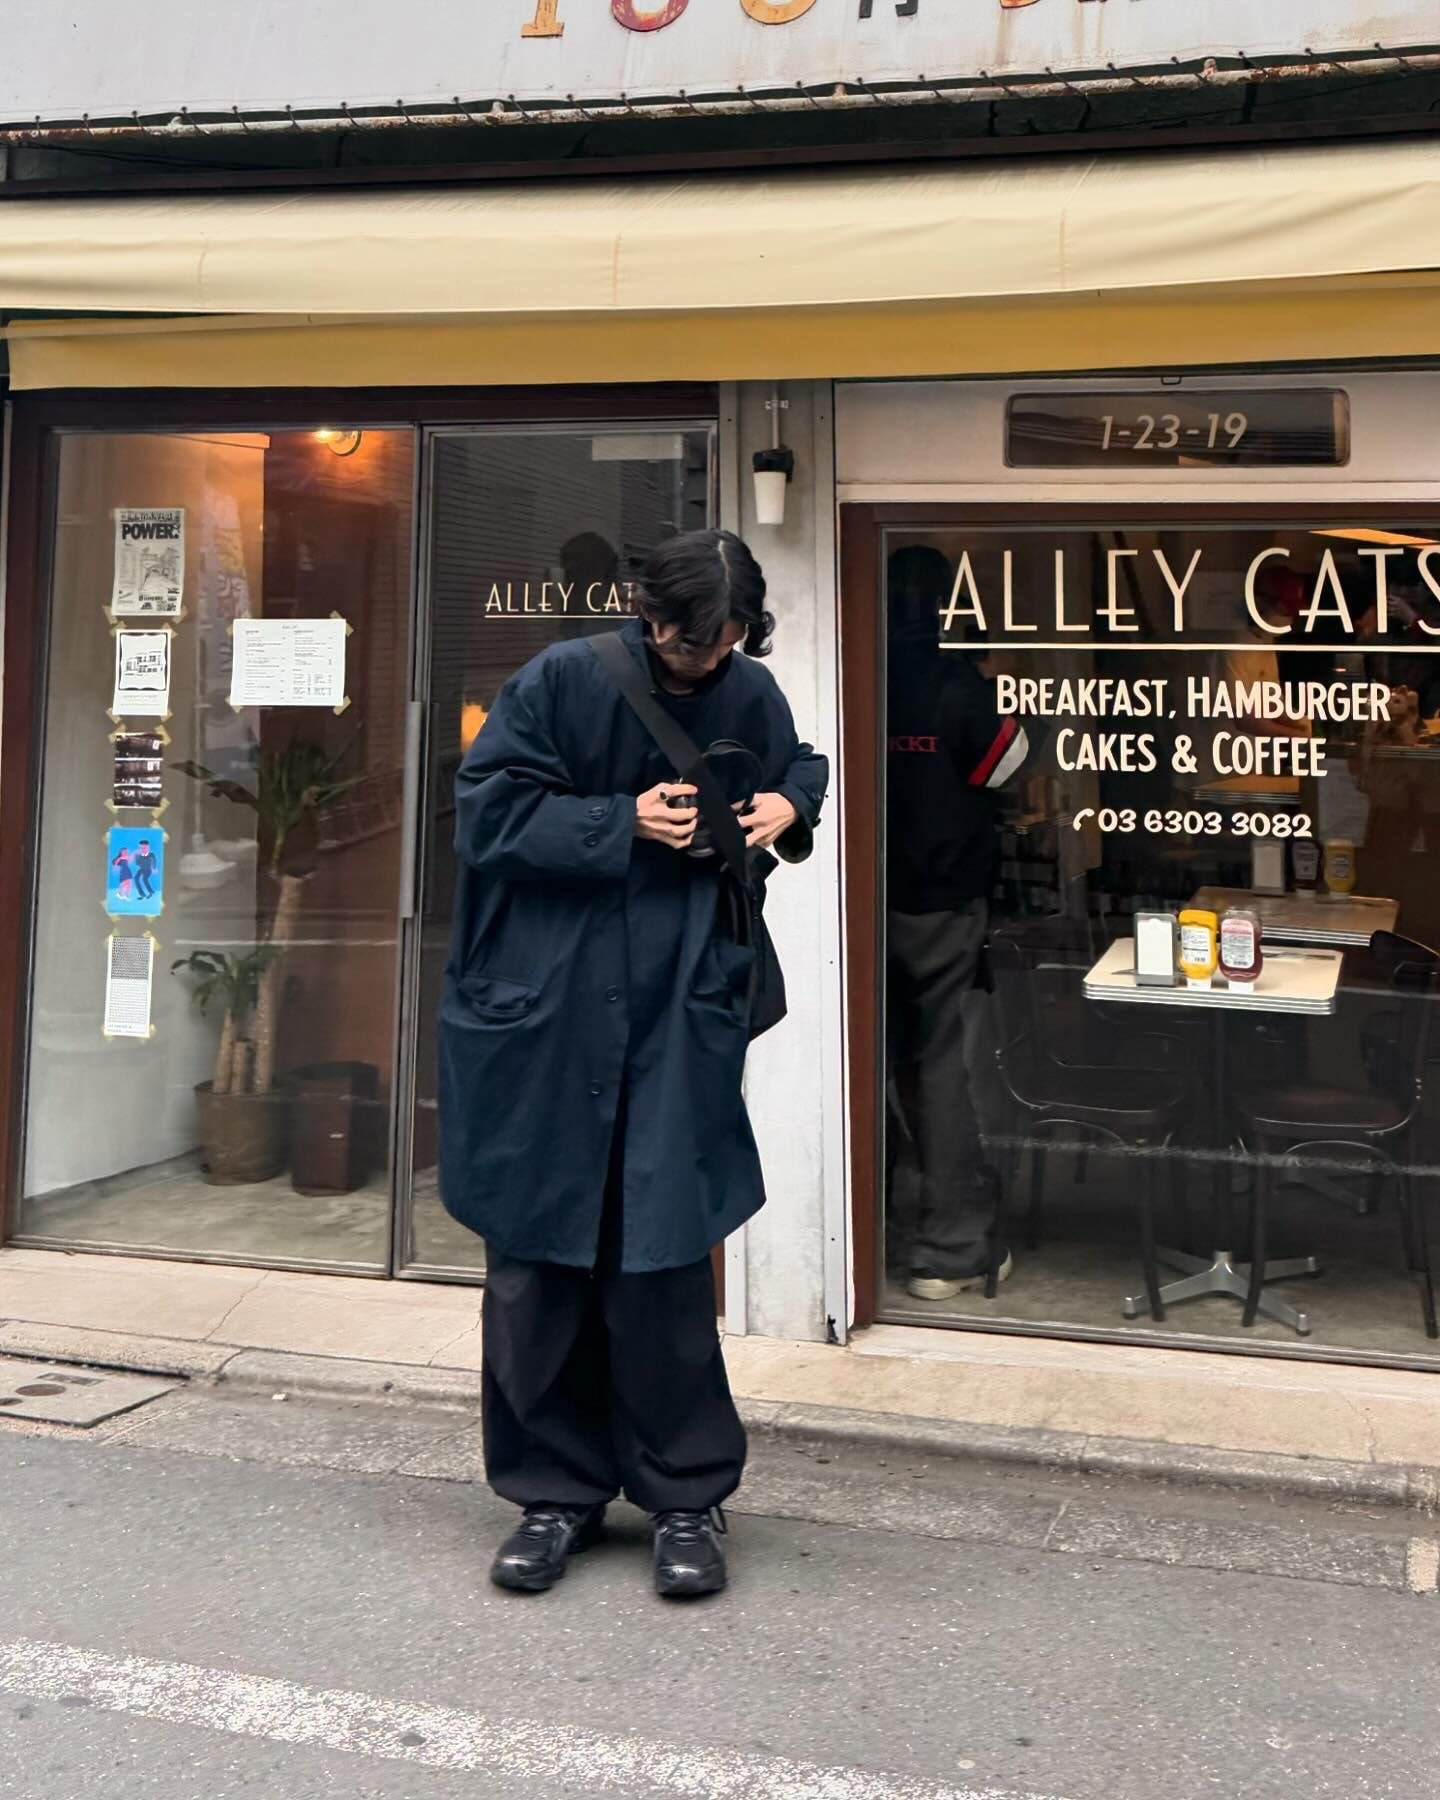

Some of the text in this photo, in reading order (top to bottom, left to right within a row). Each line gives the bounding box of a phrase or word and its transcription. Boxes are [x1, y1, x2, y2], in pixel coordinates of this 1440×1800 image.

[1101, 412, 1248, 450] 1-23-19
[484, 581, 575, 613] ALLEY
[938, 545, 1440, 635] ALLEY CATS
[996, 673, 1391, 723] BREAKFAST, HAMBURGER
[1055, 727, 1328, 778] CAKES & COFFEE
[1097, 808, 1313, 838] 03 6303 3082
